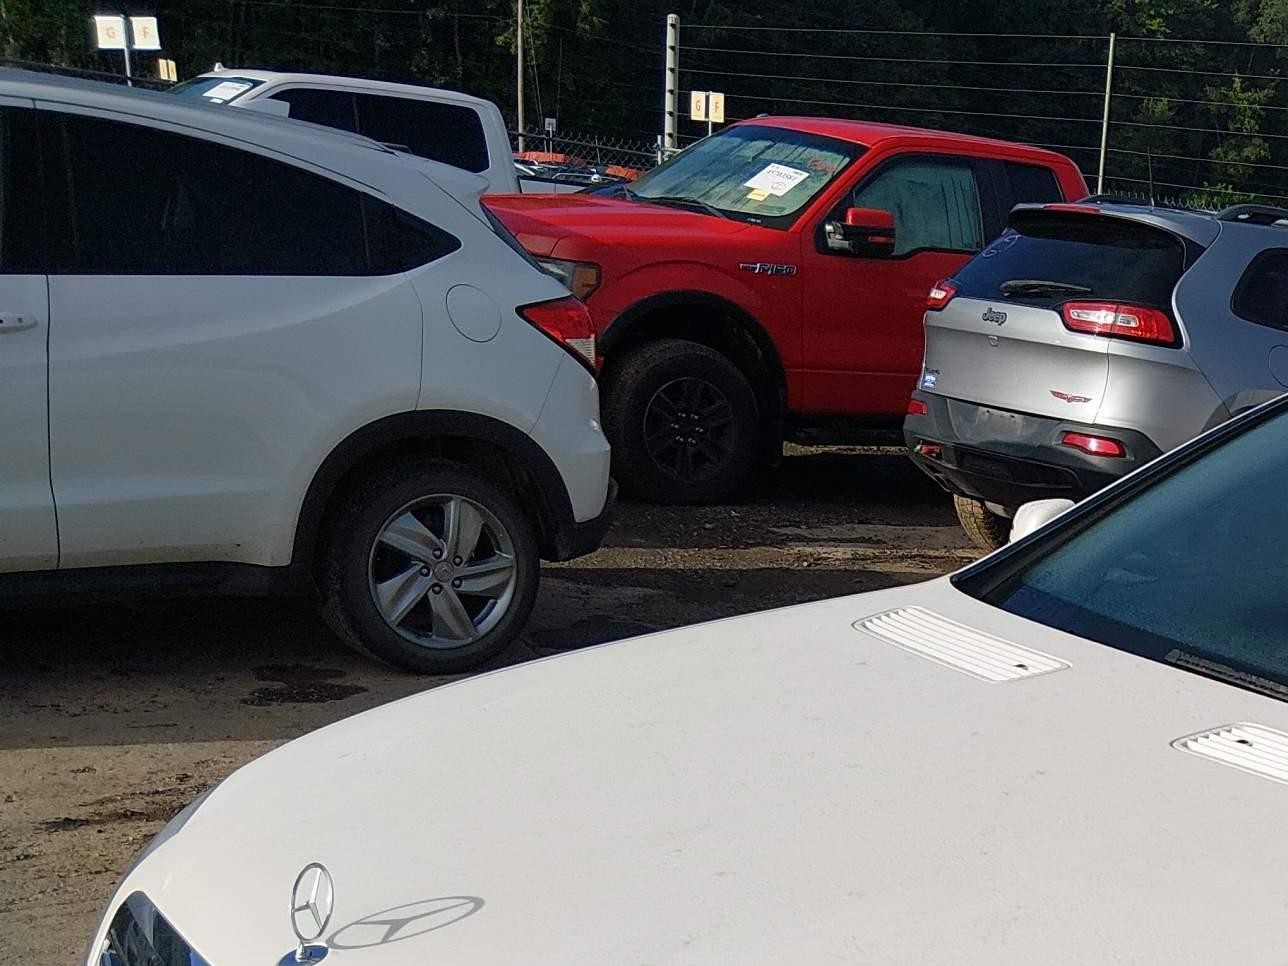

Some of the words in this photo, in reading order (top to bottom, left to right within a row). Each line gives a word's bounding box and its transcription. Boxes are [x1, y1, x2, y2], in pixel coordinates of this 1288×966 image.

[106, 26, 116, 39] G
[142, 26, 150, 39] F
[695, 99, 701, 112] G
[714, 101, 720, 113] F
[981, 307, 1008, 327] Jeep
